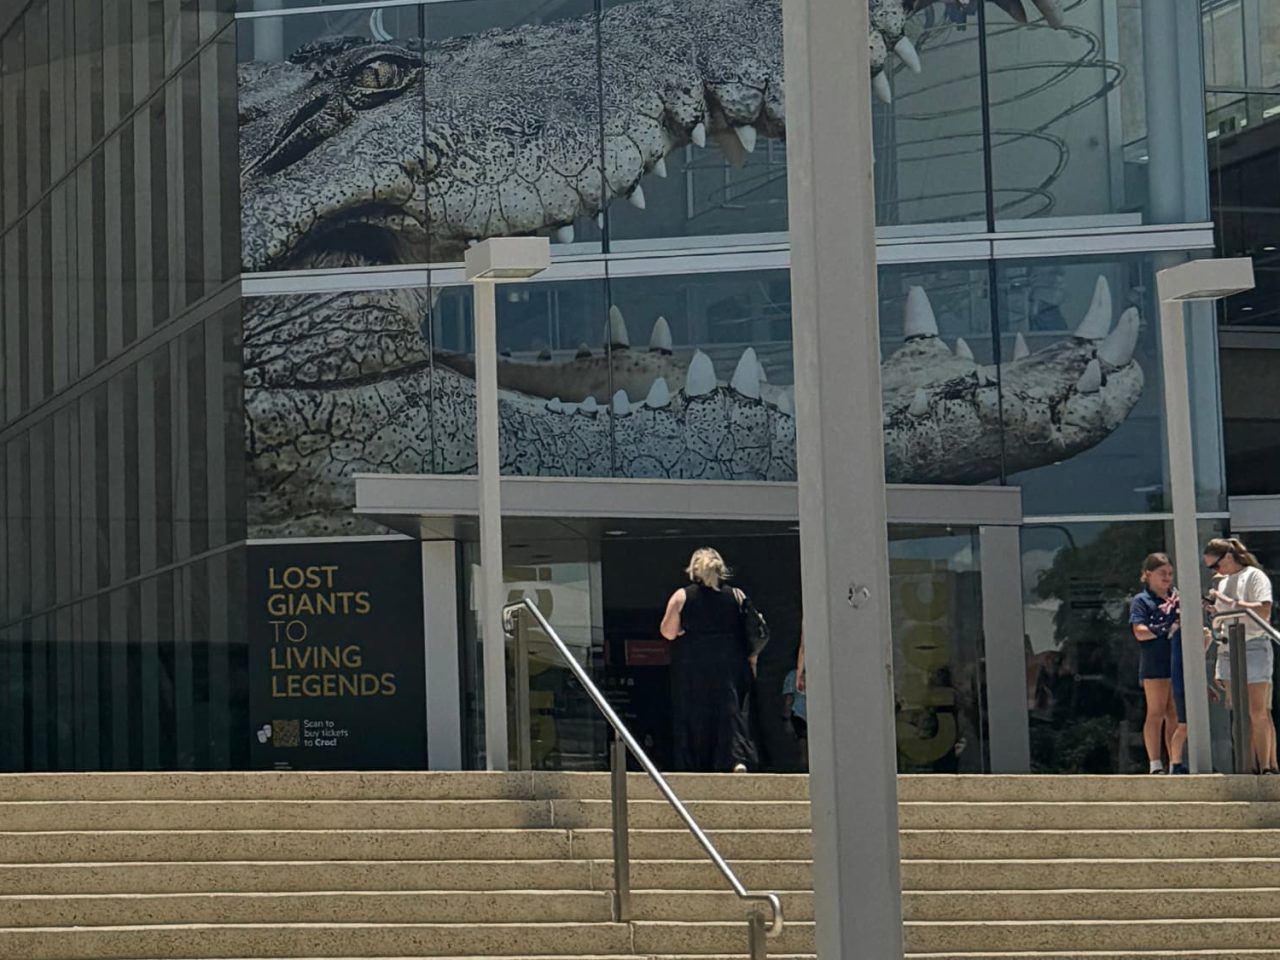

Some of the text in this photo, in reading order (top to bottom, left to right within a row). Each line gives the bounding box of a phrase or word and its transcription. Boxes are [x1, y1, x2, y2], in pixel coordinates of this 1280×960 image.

[269, 566, 338, 589] LOST
[267, 591, 370, 616] GIANTS
[269, 620, 307, 642] TO
[271, 644, 362, 669] LIVING
[271, 673, 396, 697] LEGENDS
[303, 720, 334, 728] Scan to
